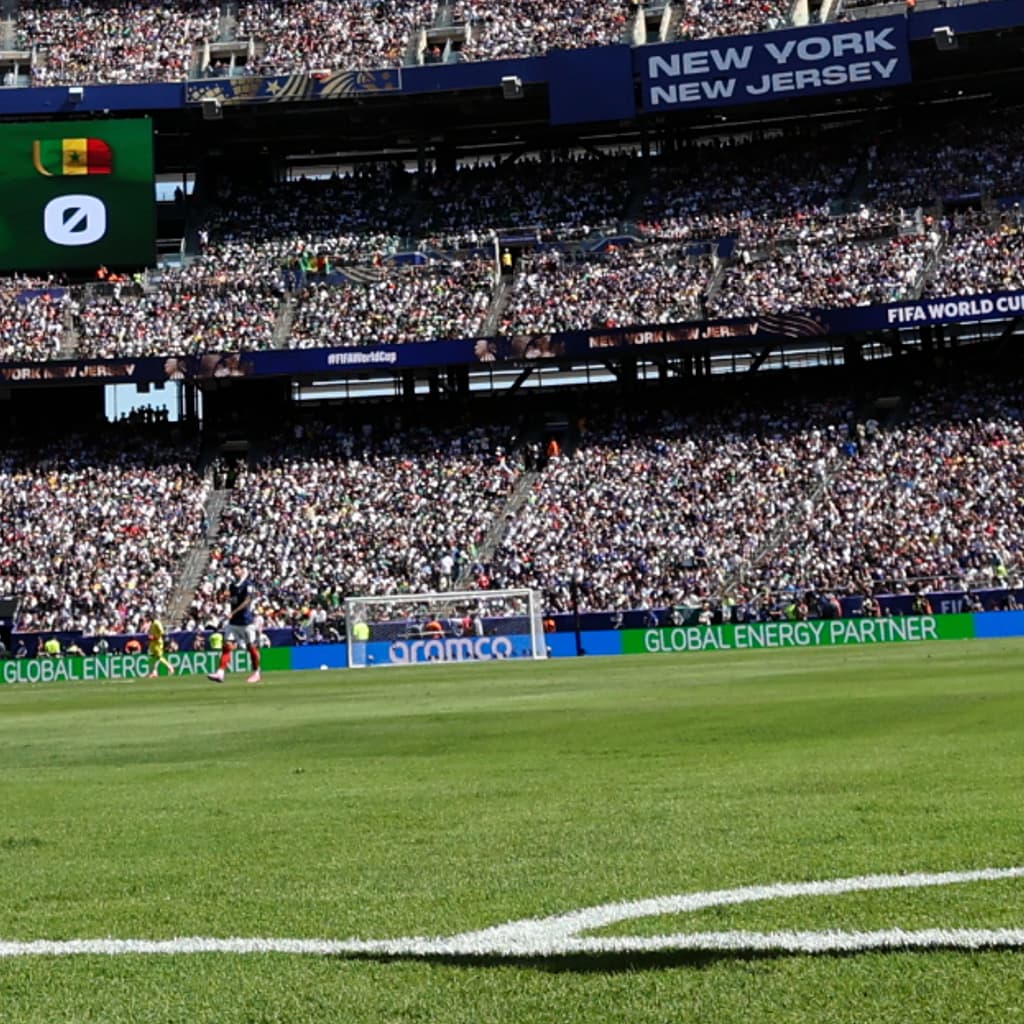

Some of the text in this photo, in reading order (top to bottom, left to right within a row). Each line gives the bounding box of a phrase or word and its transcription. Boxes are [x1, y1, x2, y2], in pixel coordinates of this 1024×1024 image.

[648, 28, 897, 78] NEW YORK
[650, 58, 898, 105] NEW JERSEY
[887, 306, 927, 323] FIFA
[927, 299, 993, 319] WORLD
[626, 331, 664, 345] YORK
[328, 350, 397, 365] #FIFAWorldCup
[2, 368, 41, 380] YORK
[644, 616, 938, 653] GLOBAL ENERGY PARTNER
[389, 637, 513, 663] aramco
[3, 659, 79, 683] GLOBAL
[83, 655, 150, 680] ENERG
